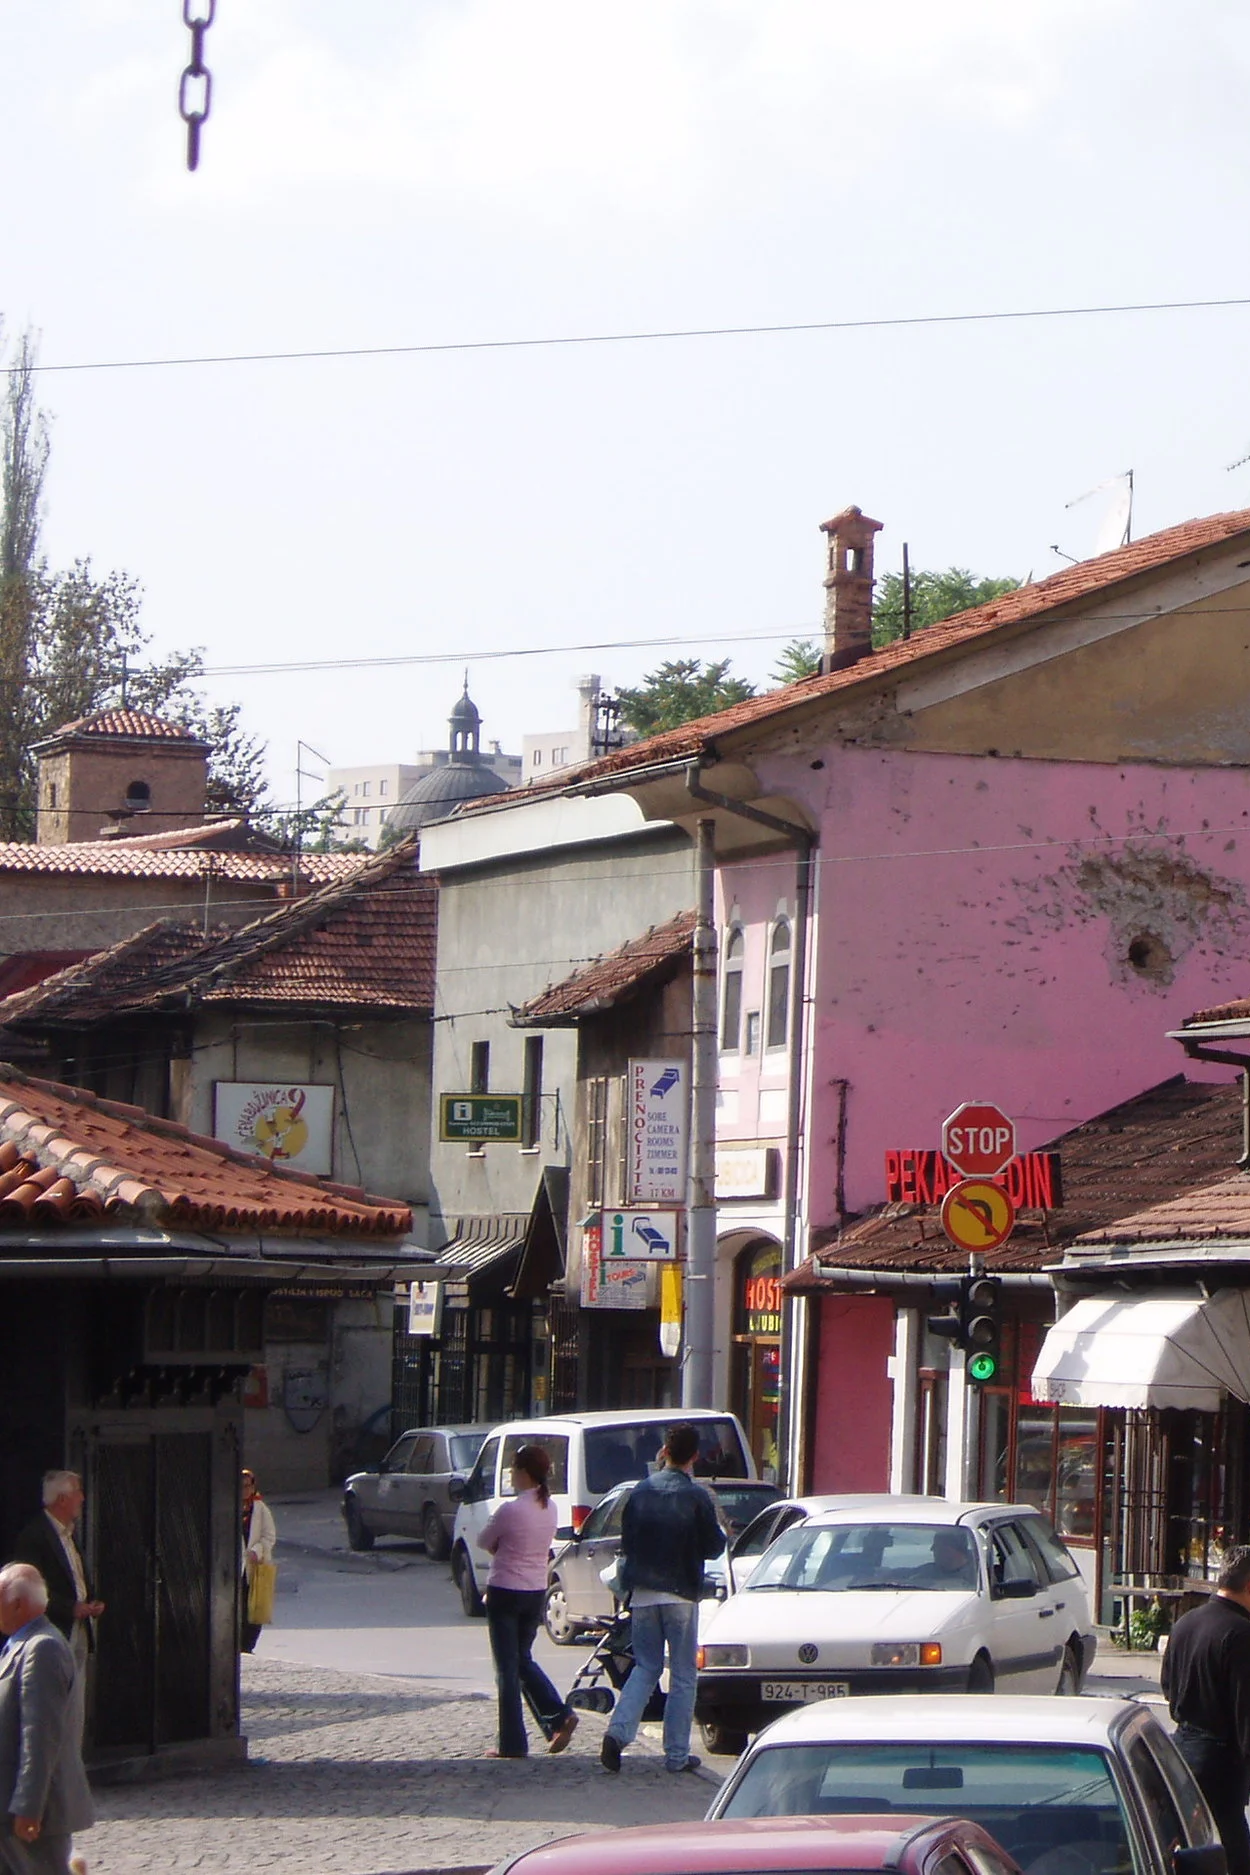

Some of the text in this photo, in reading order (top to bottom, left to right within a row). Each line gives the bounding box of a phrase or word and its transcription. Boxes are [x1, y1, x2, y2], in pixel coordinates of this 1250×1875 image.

[647, 1111, 667, 1121] SOBE
[463, 1126, 500, 1136] HOSTEL
[647, 1125, 680, 1135] CAMERA
[647, 1137, 674, 1147] ROOMS
[950, 1128, 1010, 1154] STOP
[647, 1150, 677, 1159] ZIMMER
[885, 1150, 1055, 1209] PEKA DIN
[764, 1684, 846, 1699] 924-T-985
